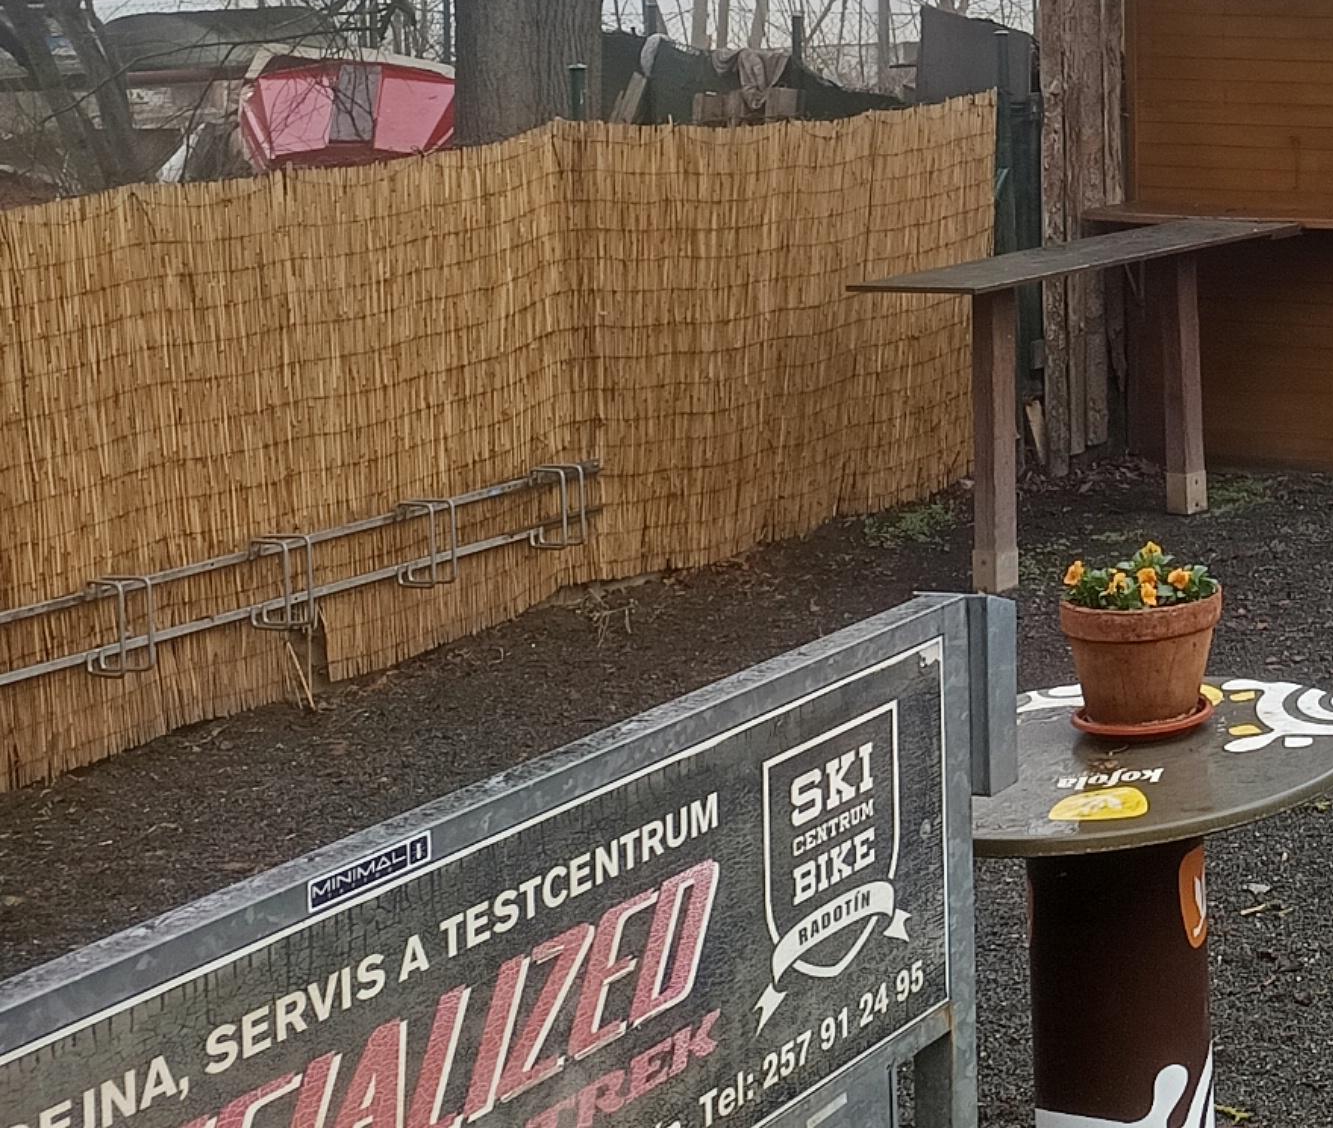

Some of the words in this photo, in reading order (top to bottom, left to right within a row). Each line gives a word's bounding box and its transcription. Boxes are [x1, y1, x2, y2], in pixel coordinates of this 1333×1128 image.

[791, 742, 873, 827] SKI
[1057, 768, 1164, 790] kofola
[793, 799, 874, 856] CENTRUM
[793, 827, 876, 906] BIKE
[312, 851, 406, 899] MINIMAL
[798, 889, 871, 946] RADOTÍN
[8, 1055, 190, 1128] EJNA,
[205, 953, 386, 1074] SERVIS
[398, 934, 430, 983] A
[439, 792, 719, 958] TESTCENTRUM
[180, 859, 720, 1128] IALIZED
[699, 1071, 754, 1128] Tel:
[763, 1029, 812, 1090] 257
[820, 1007, 848, 1051] 91
[859, 982, 888, 1028] 24
[896, 960, 924, 1002] 95
